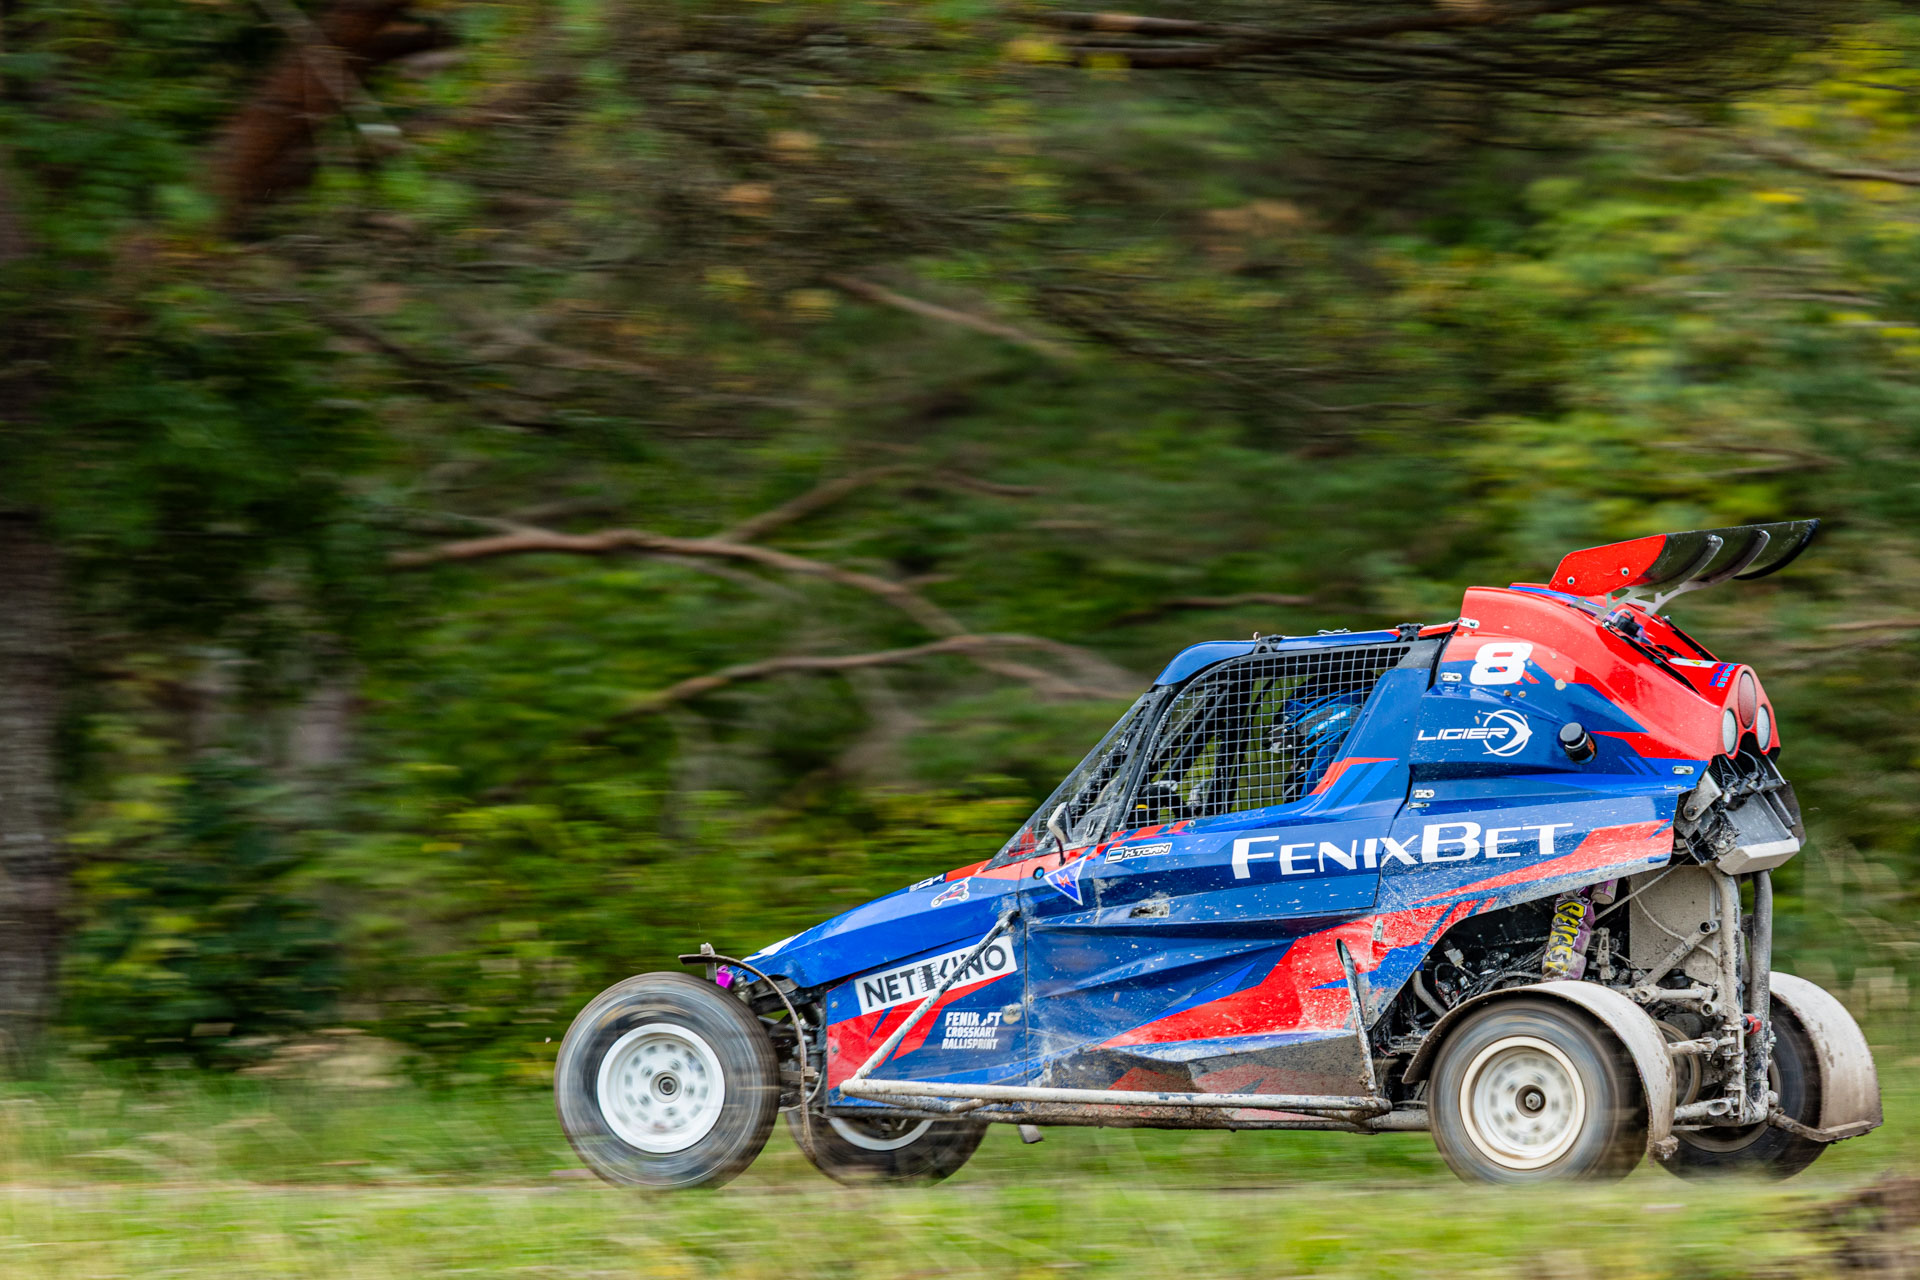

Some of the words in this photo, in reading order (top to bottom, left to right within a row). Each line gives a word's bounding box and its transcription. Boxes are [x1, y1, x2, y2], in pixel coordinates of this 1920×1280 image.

[1470, 642, 1533, 685] 8
[1417, 727, 1510, 741] LIGIER
[945, 1026, 998, 1038] CROSSKART
[941, 1038, 1000, 1050] RALLISPRINT
